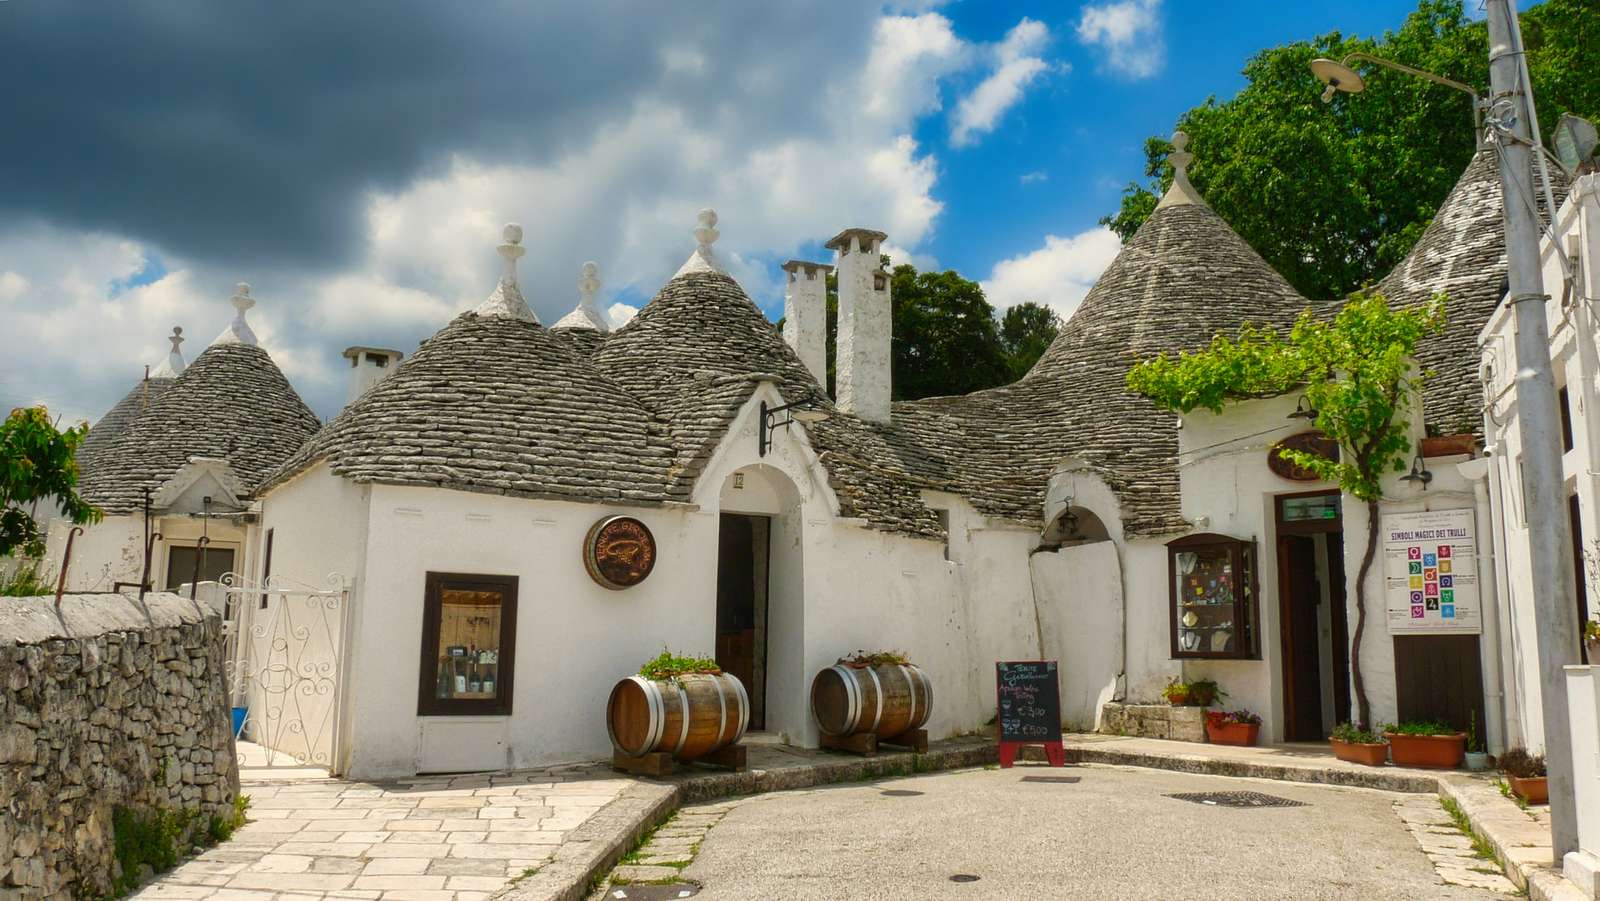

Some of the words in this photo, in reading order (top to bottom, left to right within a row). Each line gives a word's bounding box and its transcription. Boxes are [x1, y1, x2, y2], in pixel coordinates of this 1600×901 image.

[1391, 531, 1414, 541] SIMBOLI
[1414, 530, 1435, 539] MAGICI
[1436, 529, 1446, 538] DEI
[1447, 528, 1467, 537] TRULLI
